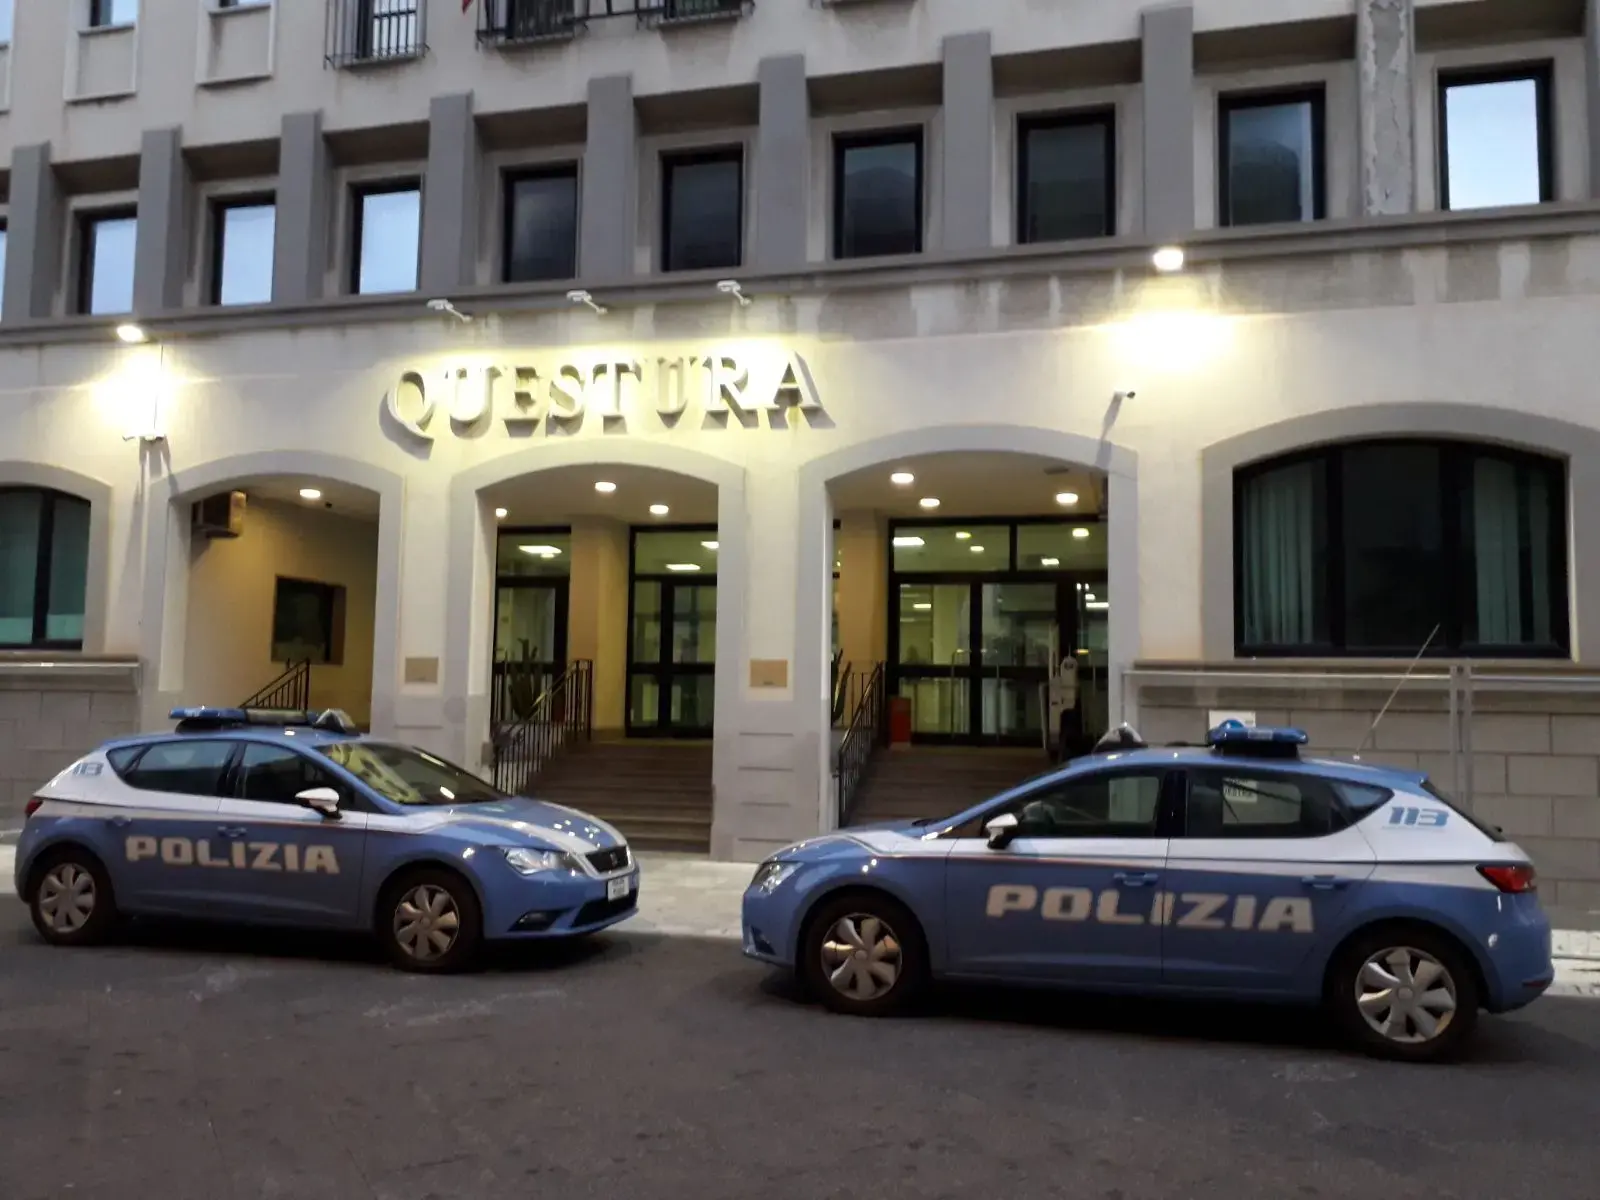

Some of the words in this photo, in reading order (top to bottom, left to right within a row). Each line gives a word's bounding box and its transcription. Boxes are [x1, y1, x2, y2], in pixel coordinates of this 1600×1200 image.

[384, 350, 833, 445] QUESTURA
[1389, 806, 1449, 826] 113
[125, 835, 340, 874] POLIZIA
[986, 884, 1314, 933] POLIZIA
